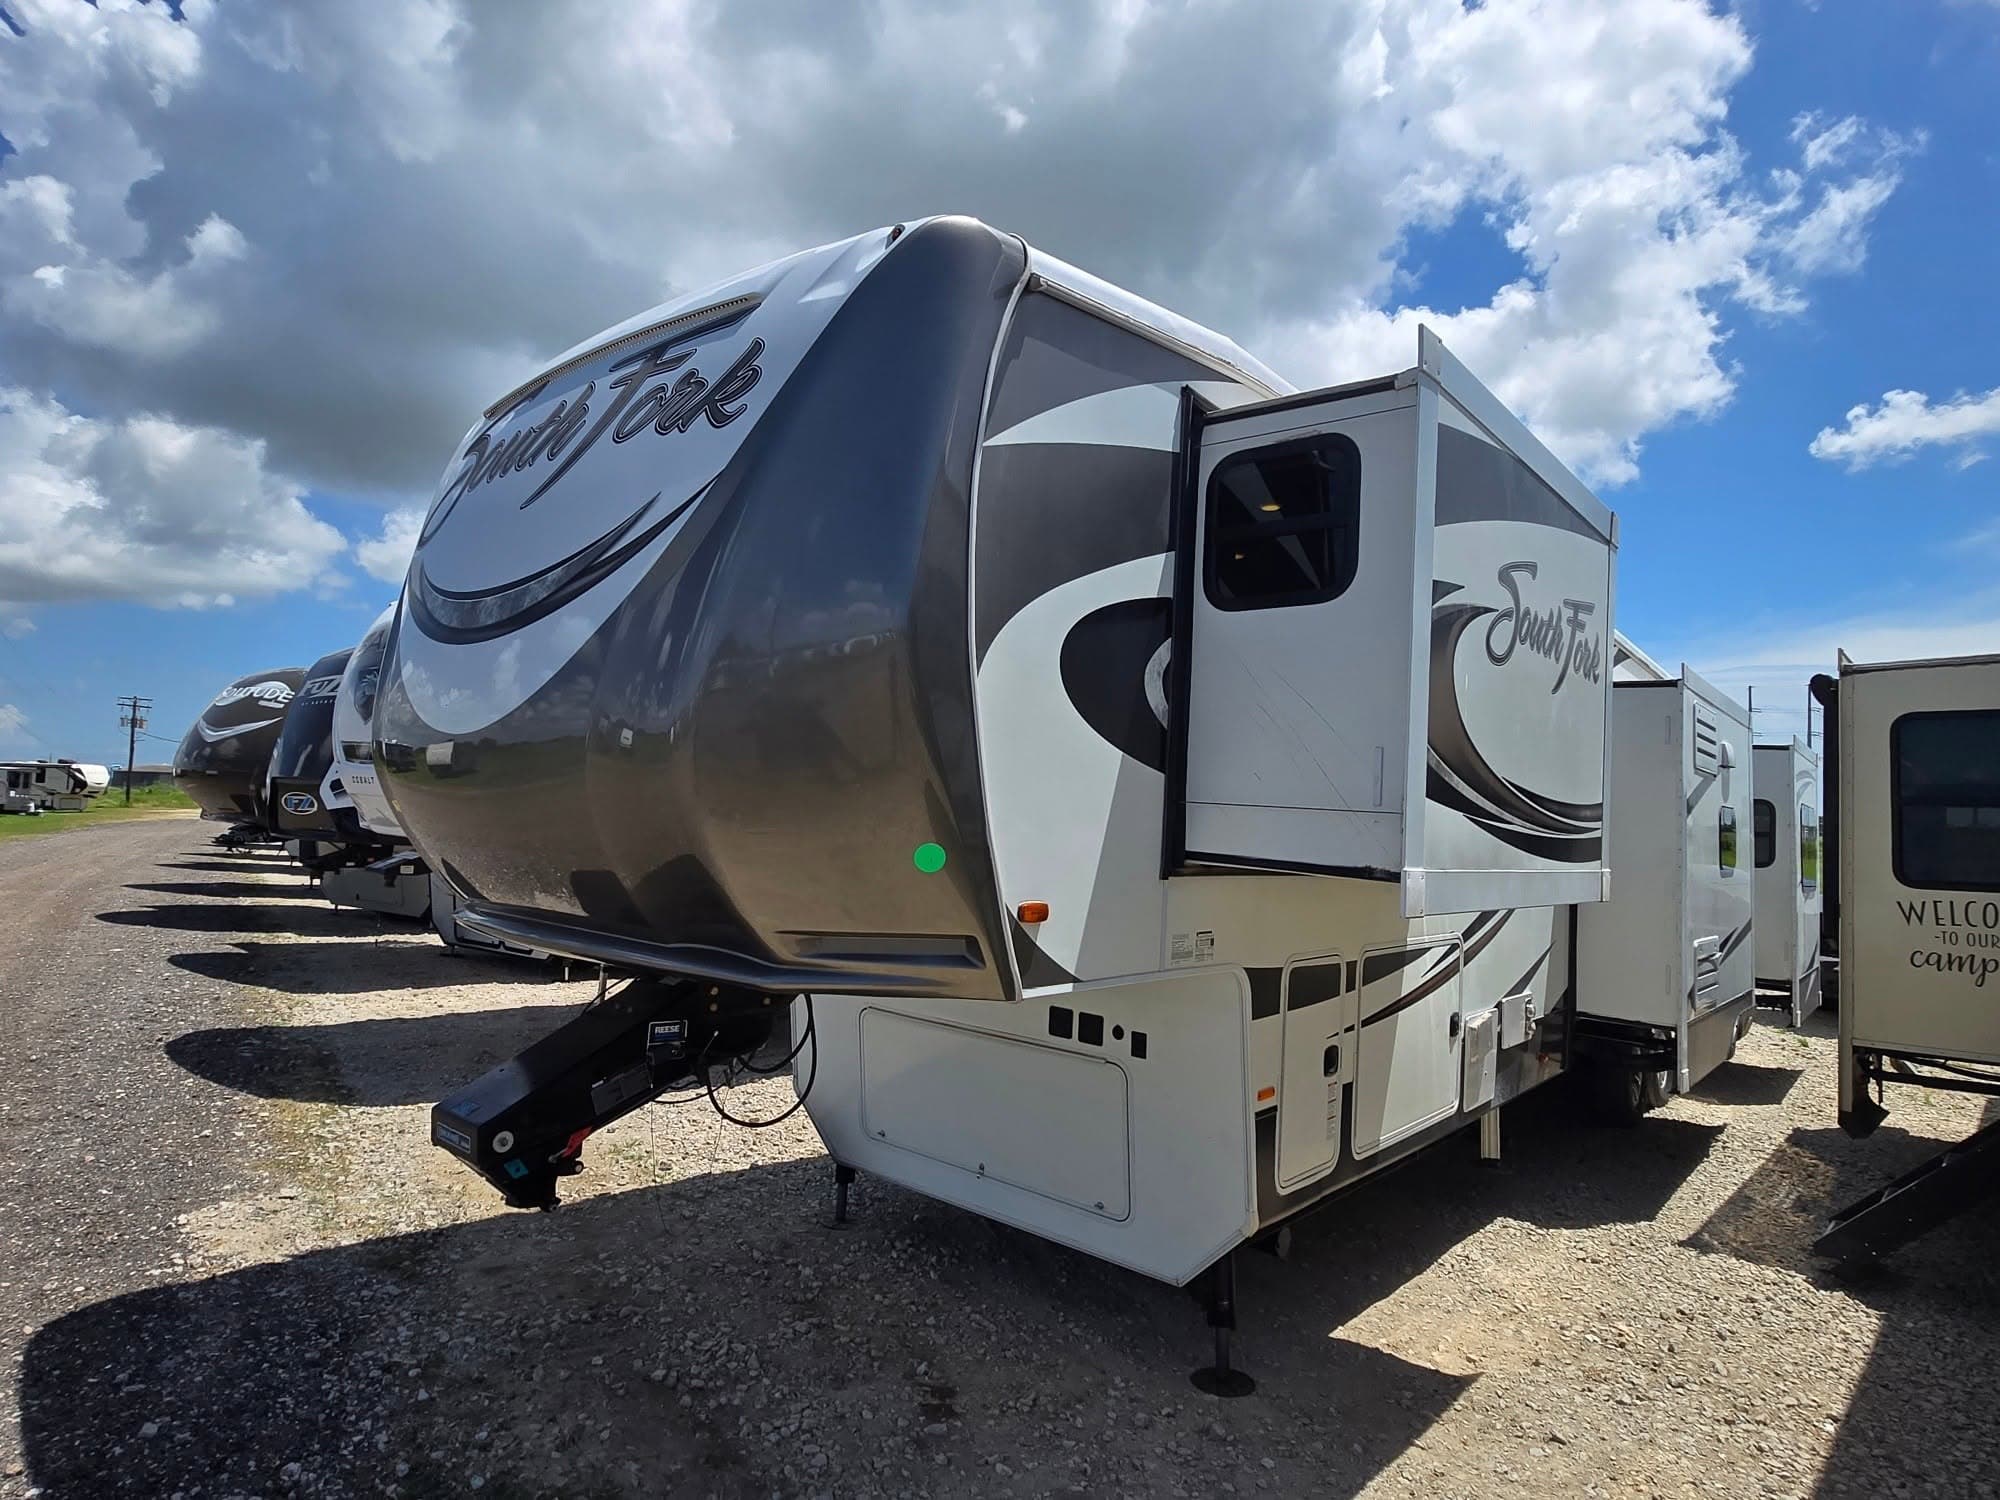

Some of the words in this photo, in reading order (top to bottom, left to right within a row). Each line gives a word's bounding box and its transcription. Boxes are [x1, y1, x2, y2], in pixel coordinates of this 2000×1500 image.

[416, 381, 596, 548] South
[520, 337, 766, 511] Fork
[1486, 560, 1564, 666] South
[1551, 598, 1600, 694] Fork
[352, 775, 375, 785] COBALT
[1896, 900, 2000, 929] WELCO
[1966, 932, 2000, 949] OUR
[1910, 950, 2000, 988] camp
[655, 1025, 681, 1034] REESE
